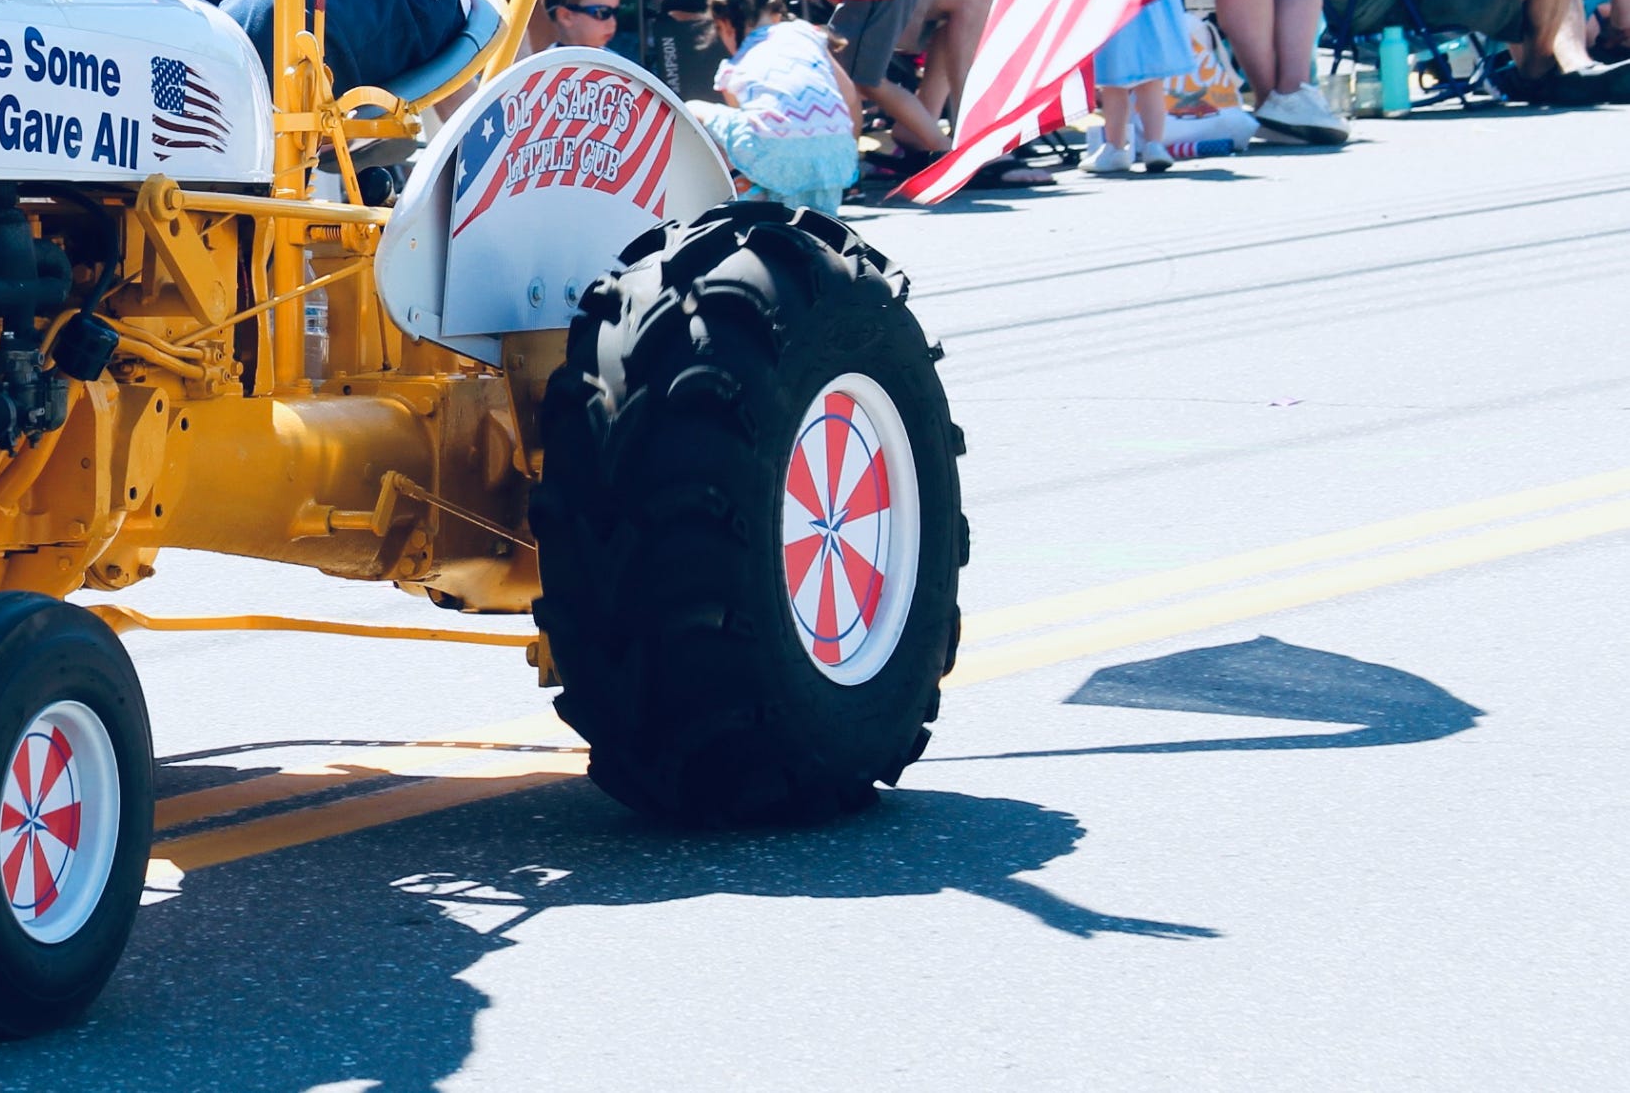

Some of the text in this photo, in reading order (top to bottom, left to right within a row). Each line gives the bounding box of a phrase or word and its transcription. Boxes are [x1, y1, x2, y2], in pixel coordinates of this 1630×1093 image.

[23, 26, 121, 97] Some
[555, 79, 636, 133] SARG'S
[94, 112, 140, 170] All
[505, 136, 622, 189] LITTLE CUB
